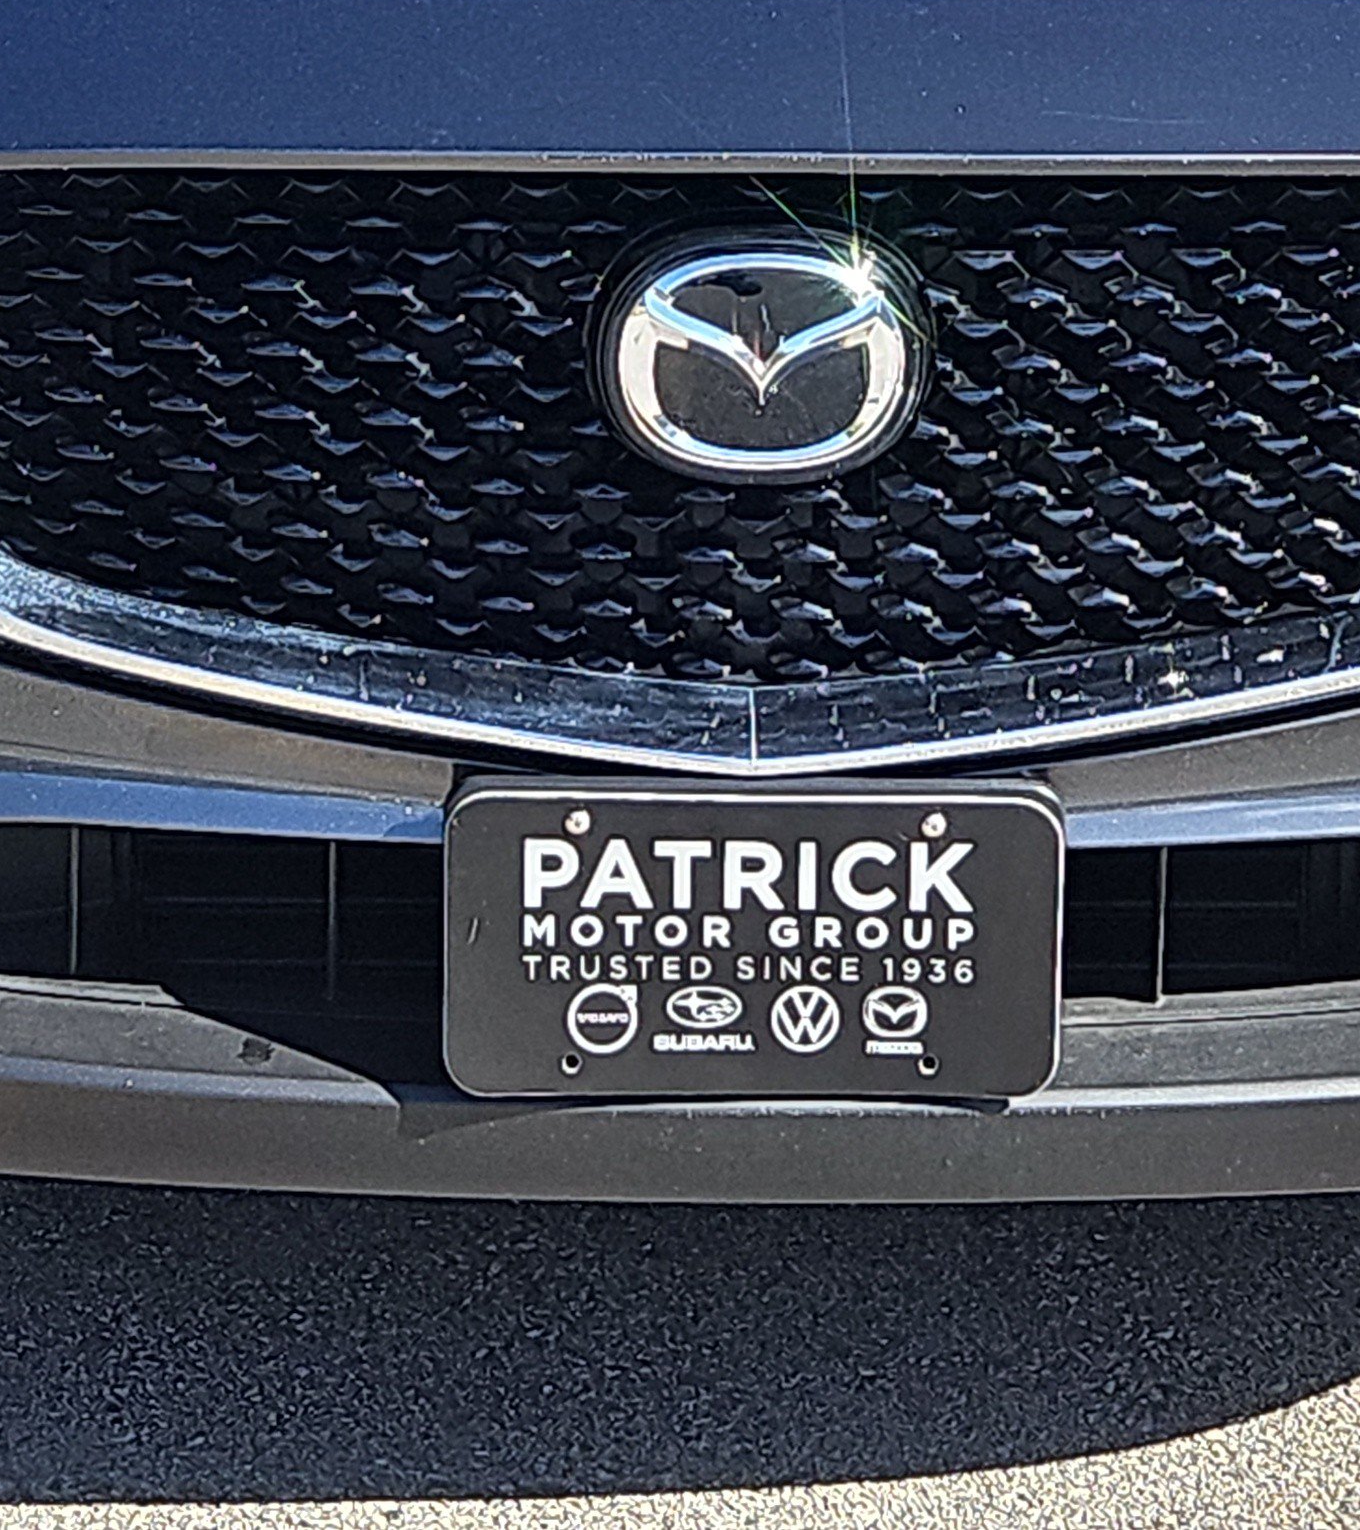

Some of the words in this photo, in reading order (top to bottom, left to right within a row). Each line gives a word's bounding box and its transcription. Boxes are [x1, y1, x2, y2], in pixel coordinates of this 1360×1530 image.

[523, 837, 975, 914] PATRICK
[523, 915, 733, 949] MOTOR
[769, 916, 976, 951] GROUP
[523, 955, 713, 981] TRUSTED
[736, 956, 861, 982] SINCE
[881, 958, 975, 984] 1936
[653, 1034, 756, 1052] SUBARU
